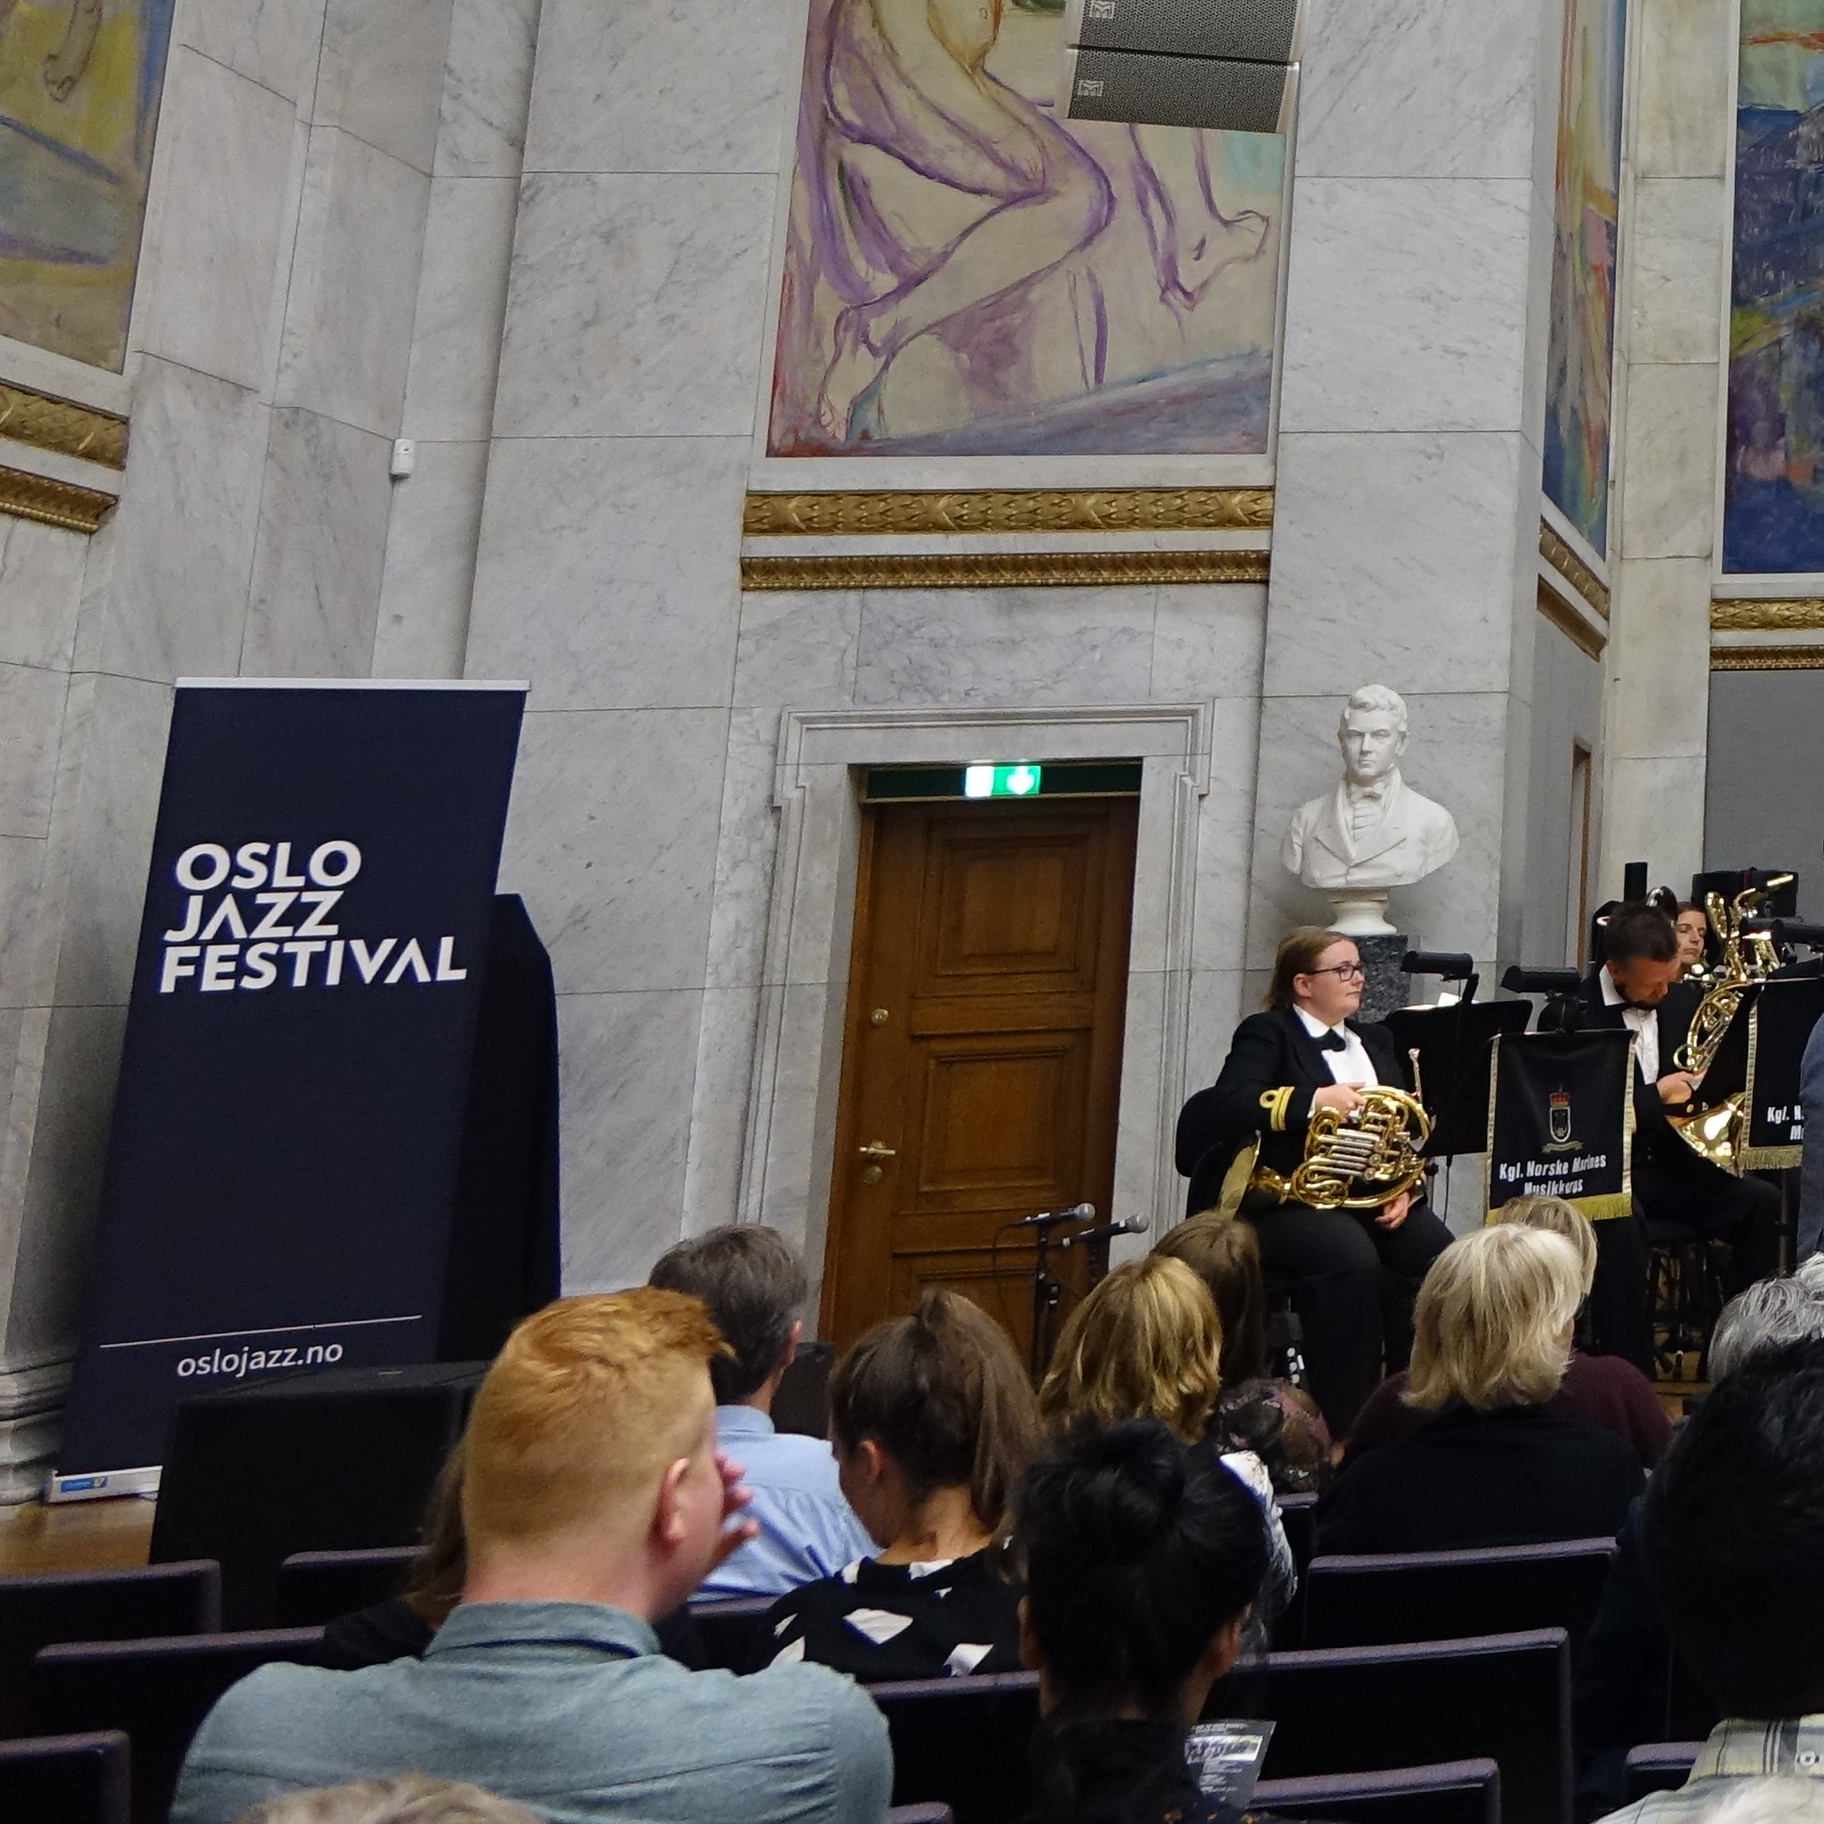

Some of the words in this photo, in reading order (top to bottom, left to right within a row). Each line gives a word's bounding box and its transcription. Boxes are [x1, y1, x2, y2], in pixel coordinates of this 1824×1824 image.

[176, 840, 362, 890] OSLO
[163, 890, 345, 942] JAZZ
[159, 936, 468, 993] FESTIVAL
[1767, 1105, 1790, 1124] Kgl.
[1499, 1162, 1524, 1182] Kgl.
[1526, 1159, 1569, 1177] Norske
[177, 1343, 344, 1378] oslojazz.no
